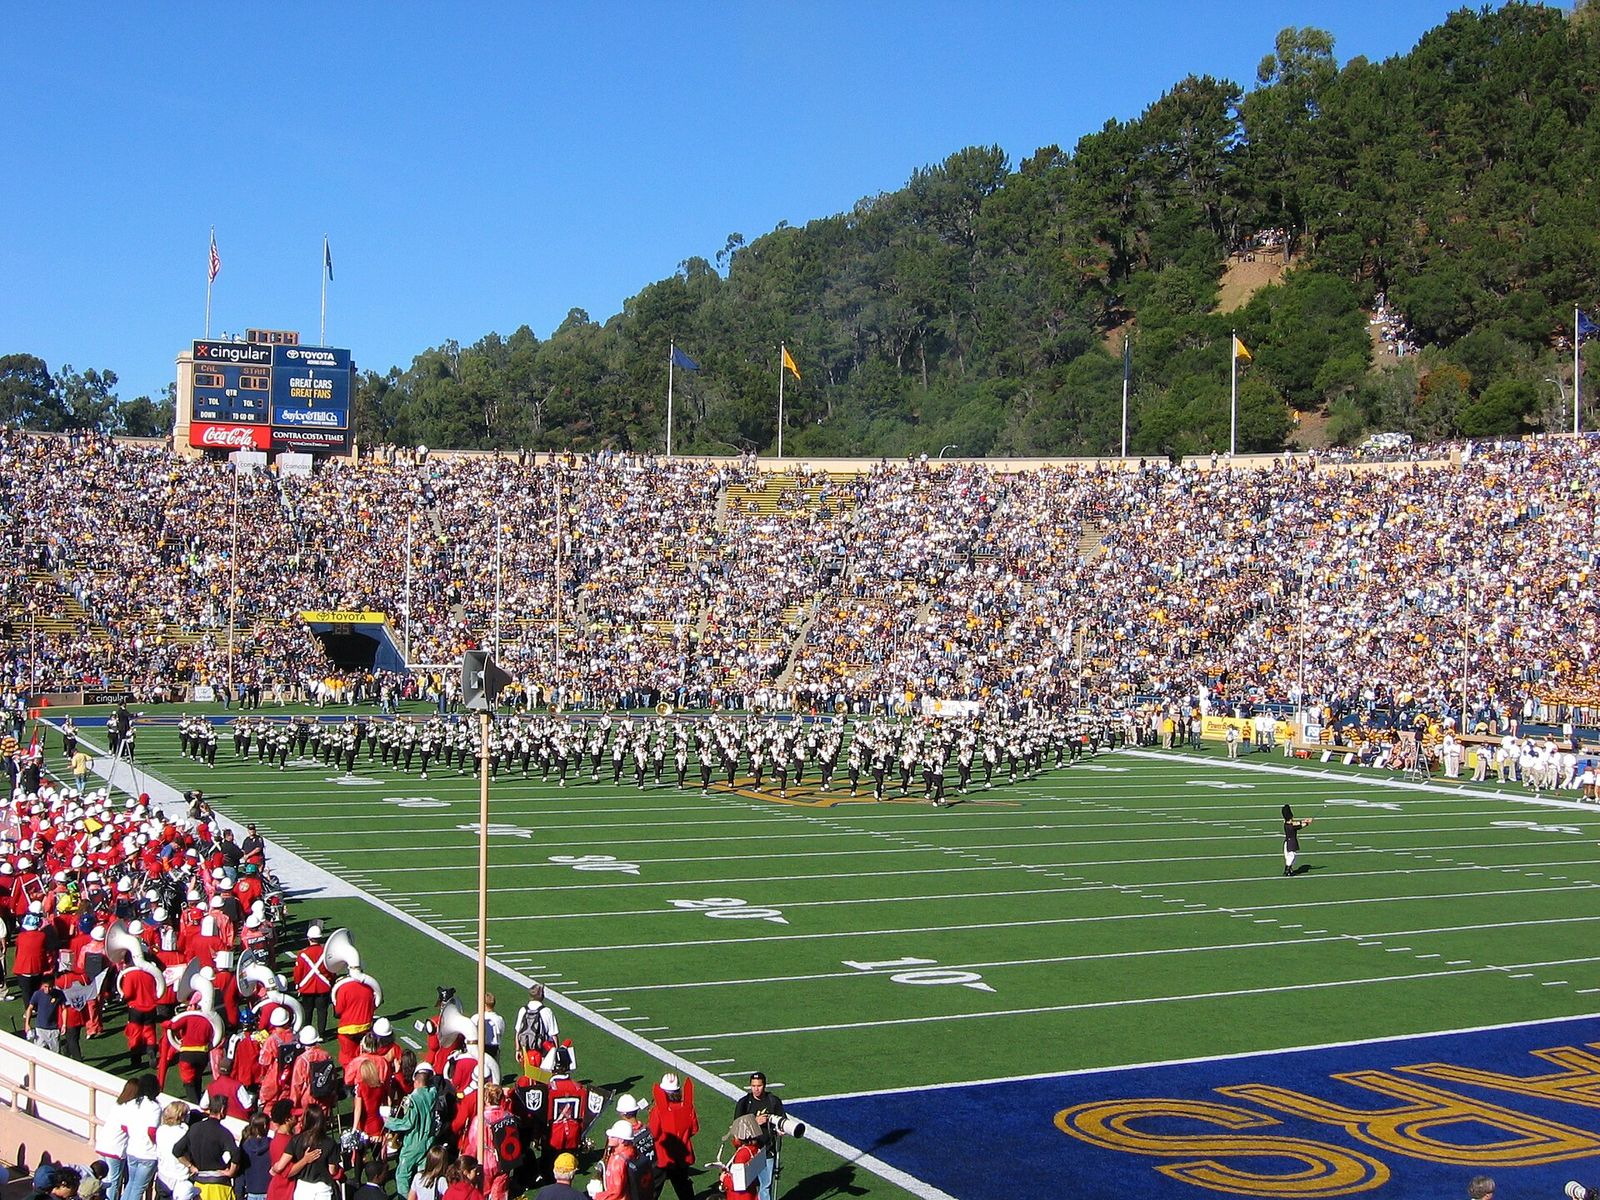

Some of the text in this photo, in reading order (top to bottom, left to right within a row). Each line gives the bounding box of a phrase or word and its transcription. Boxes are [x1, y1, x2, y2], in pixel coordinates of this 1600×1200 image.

[210, 345, 265, 362] cingular
[299, 350, 335, 360] TOYOTA
[290, 378, 333, 389] GREAT CARS
[291, 388, 332, 399] GREAT FANS
[203, 426, 254, 446] Coca-Cola
[272, 431, 301, 439] CONTRA
[302, 432, 324, 440] COSTA
[331, 612, 366, 621] TOYOTA
[841, 957, 983, 985] 10
